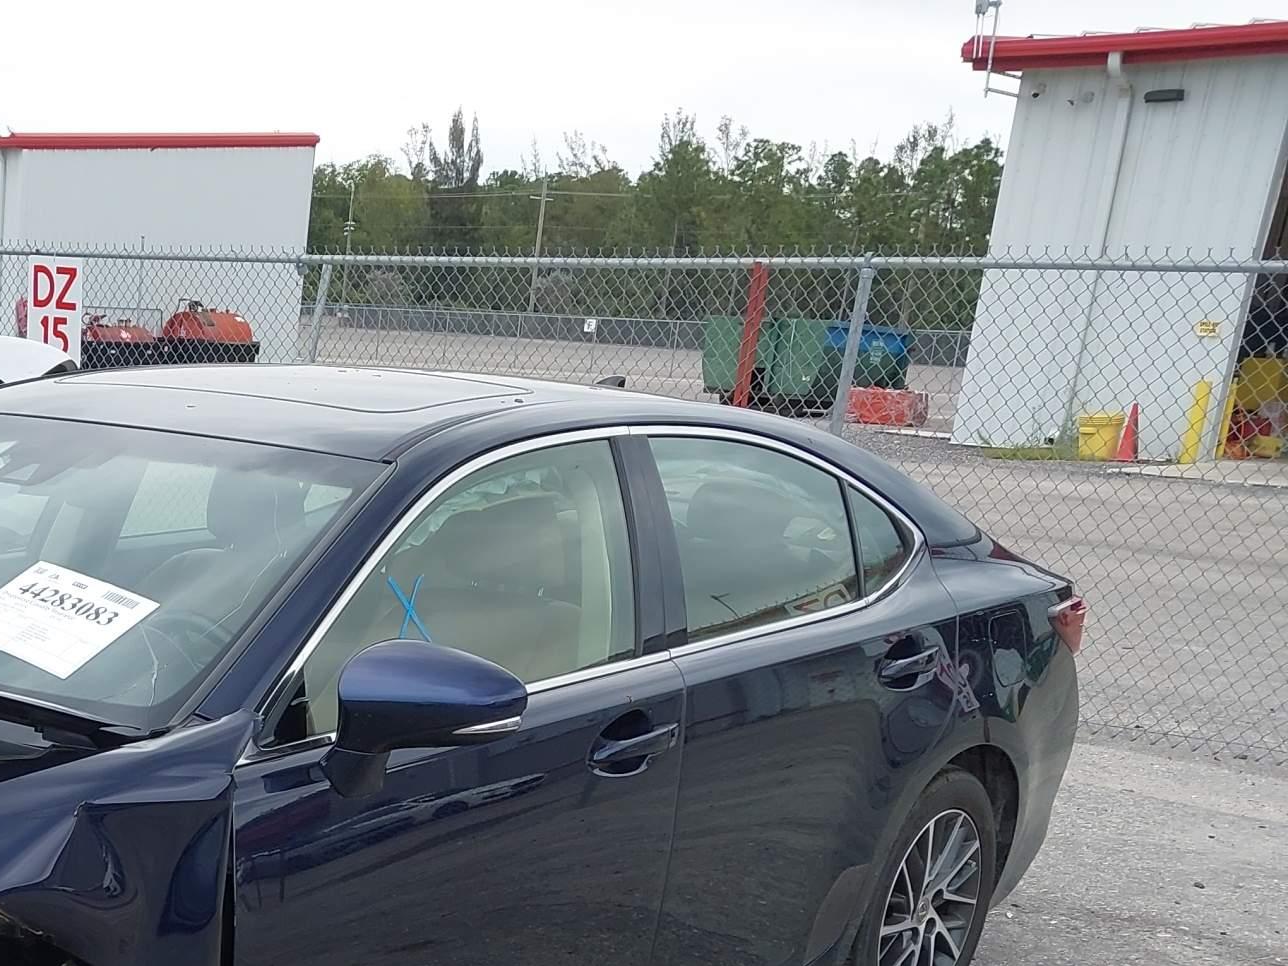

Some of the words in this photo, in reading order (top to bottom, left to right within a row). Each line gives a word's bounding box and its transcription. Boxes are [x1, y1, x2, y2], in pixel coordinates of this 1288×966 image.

[33, 264, 78, 311] DZ
[40, 315, 69, 353] 15
[18, 581, 120, 627] 44283083
